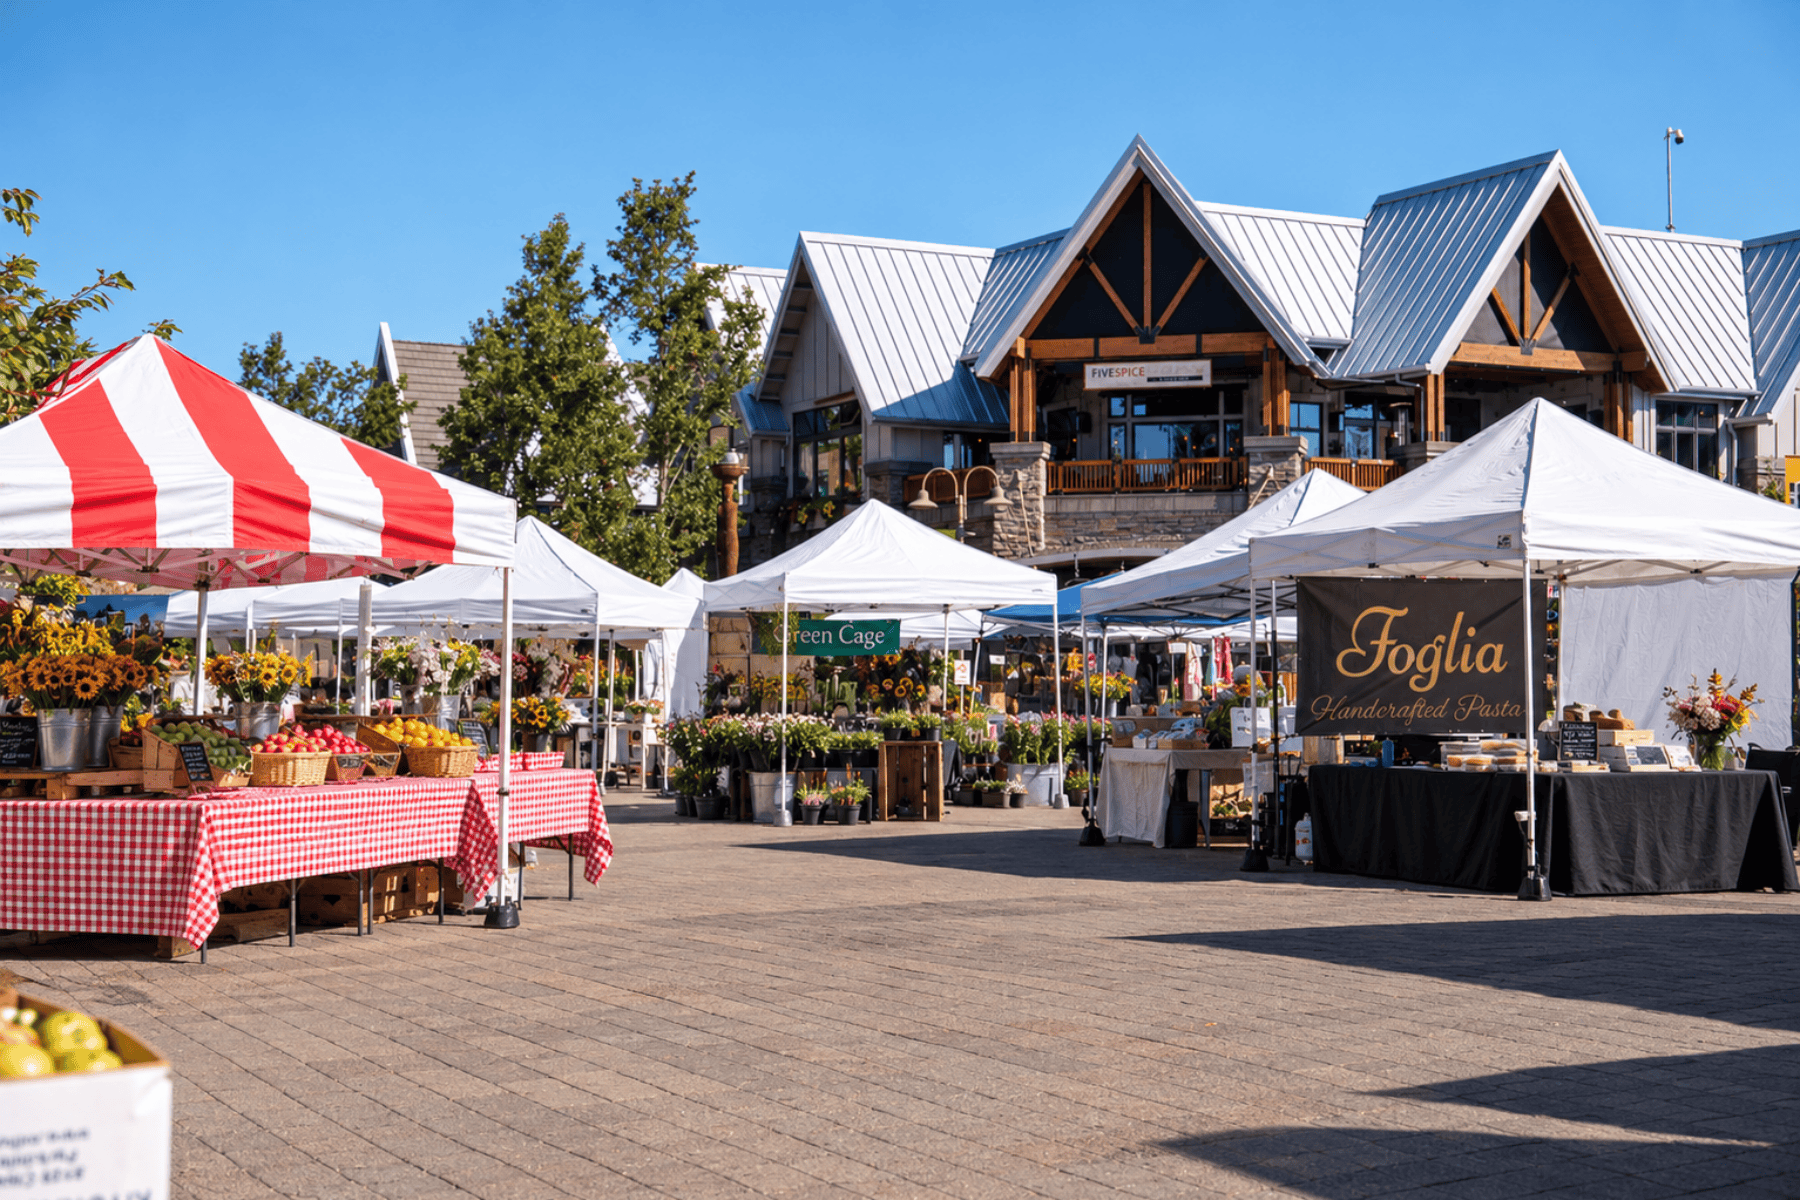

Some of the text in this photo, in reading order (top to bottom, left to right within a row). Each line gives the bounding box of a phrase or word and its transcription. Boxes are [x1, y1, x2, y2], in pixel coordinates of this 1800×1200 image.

[1091, 366, 1145, 378] FIVESPICE
[838, 624, 885, 650] Cage
[1336, 605, 1508, 693] Foglia
[1311, 694, 1526, 726] Handcrafted Pasta
